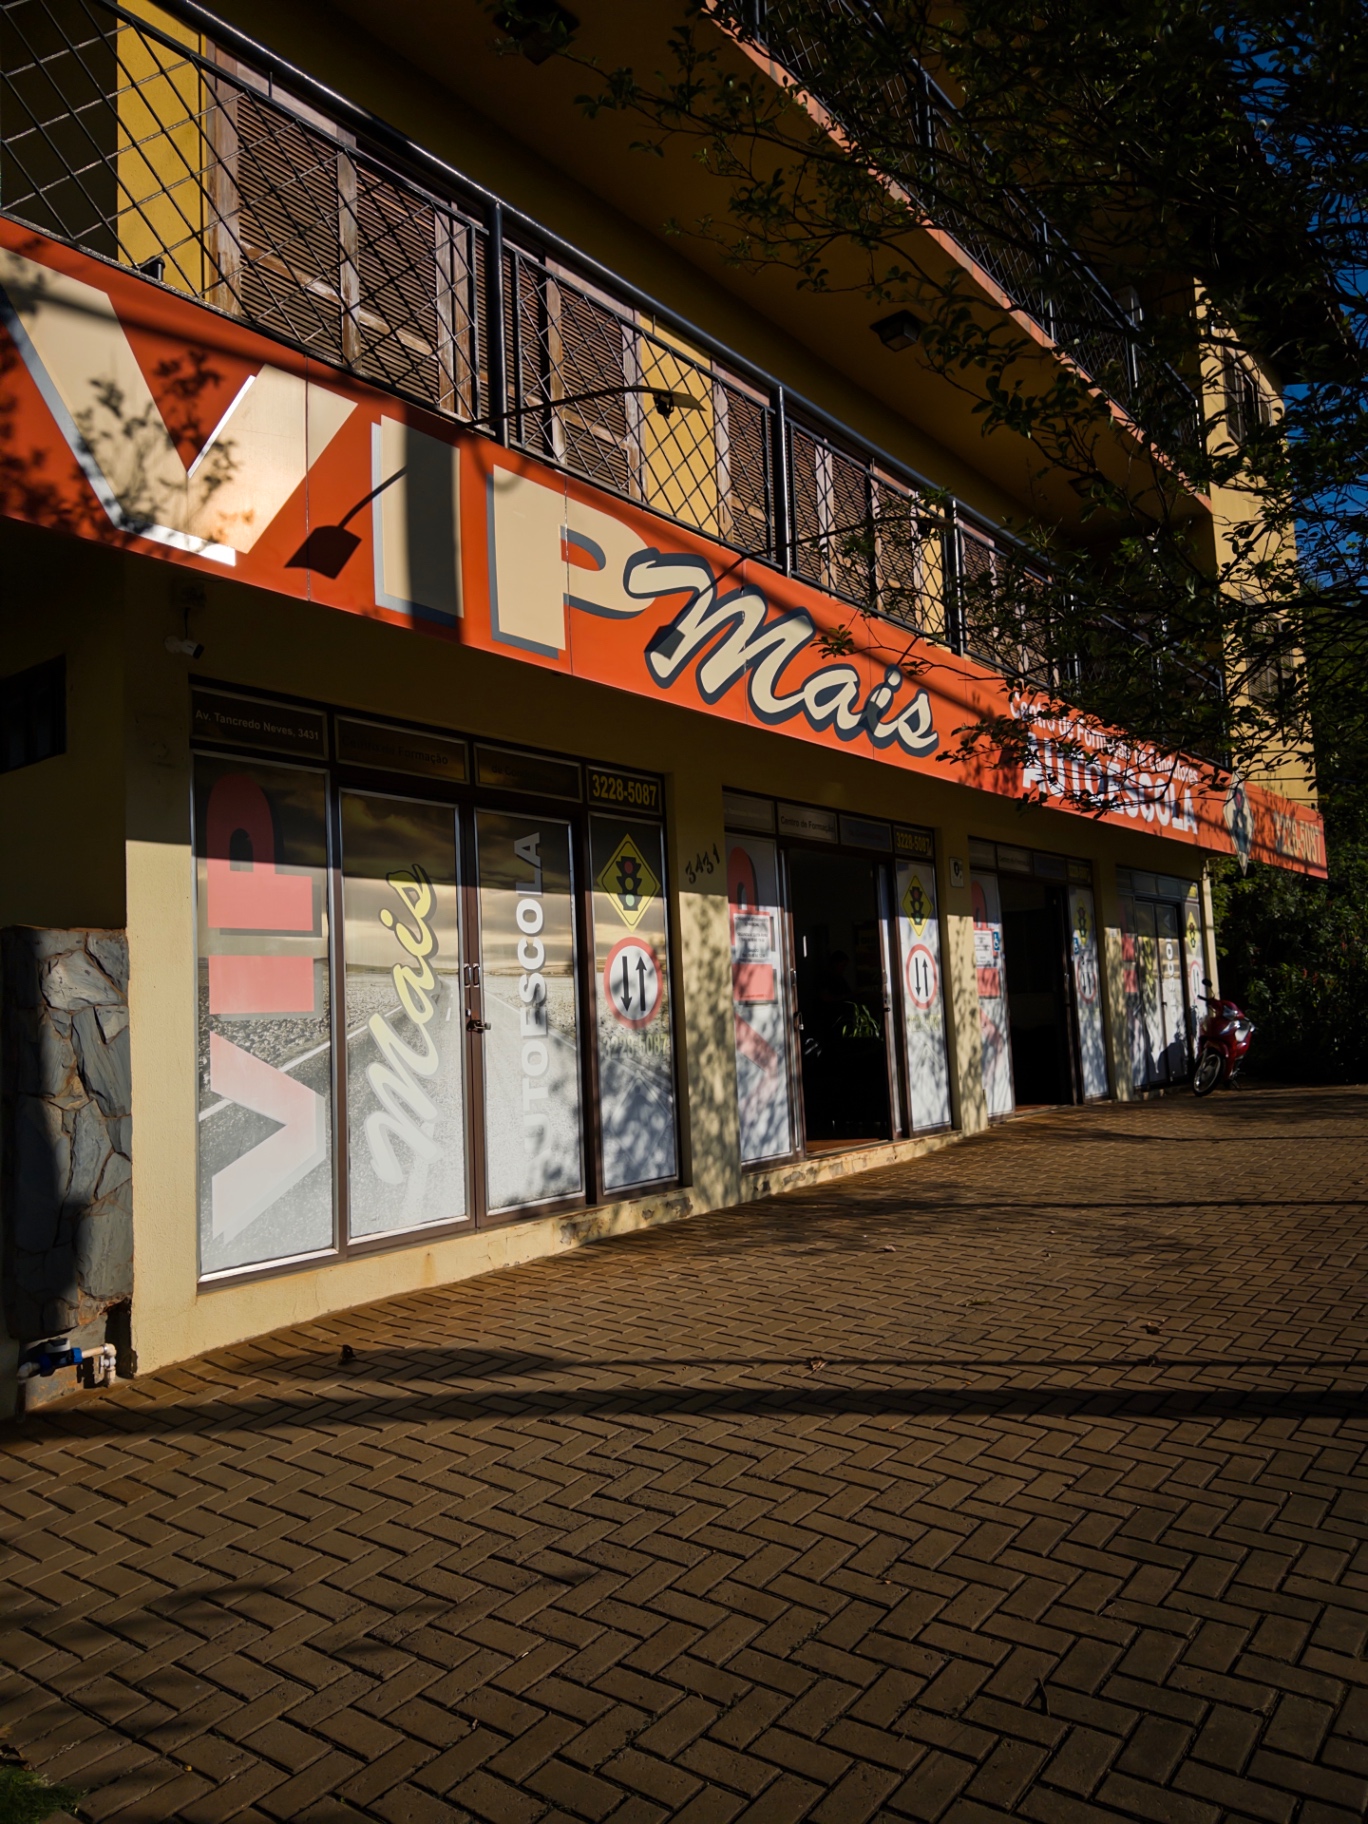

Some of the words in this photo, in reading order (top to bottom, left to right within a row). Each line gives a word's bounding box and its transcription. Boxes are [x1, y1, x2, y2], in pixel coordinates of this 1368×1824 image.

[0, 247, 652, 658] VIP
[624, 548, 940, 758] Mais
[195, 709, 212, 721] Av.
[214, 711, 262, 730] Tancredo
[263, 721, 296, 738] Neves,
[297, 728, 320, 741] 3431
[592, 773, 657, 807] 3228-5087
[685, 843, 720, 884] 3431
[207, 774, 323, 1240] VIP
[364, 863, 443, 1184] Mais
